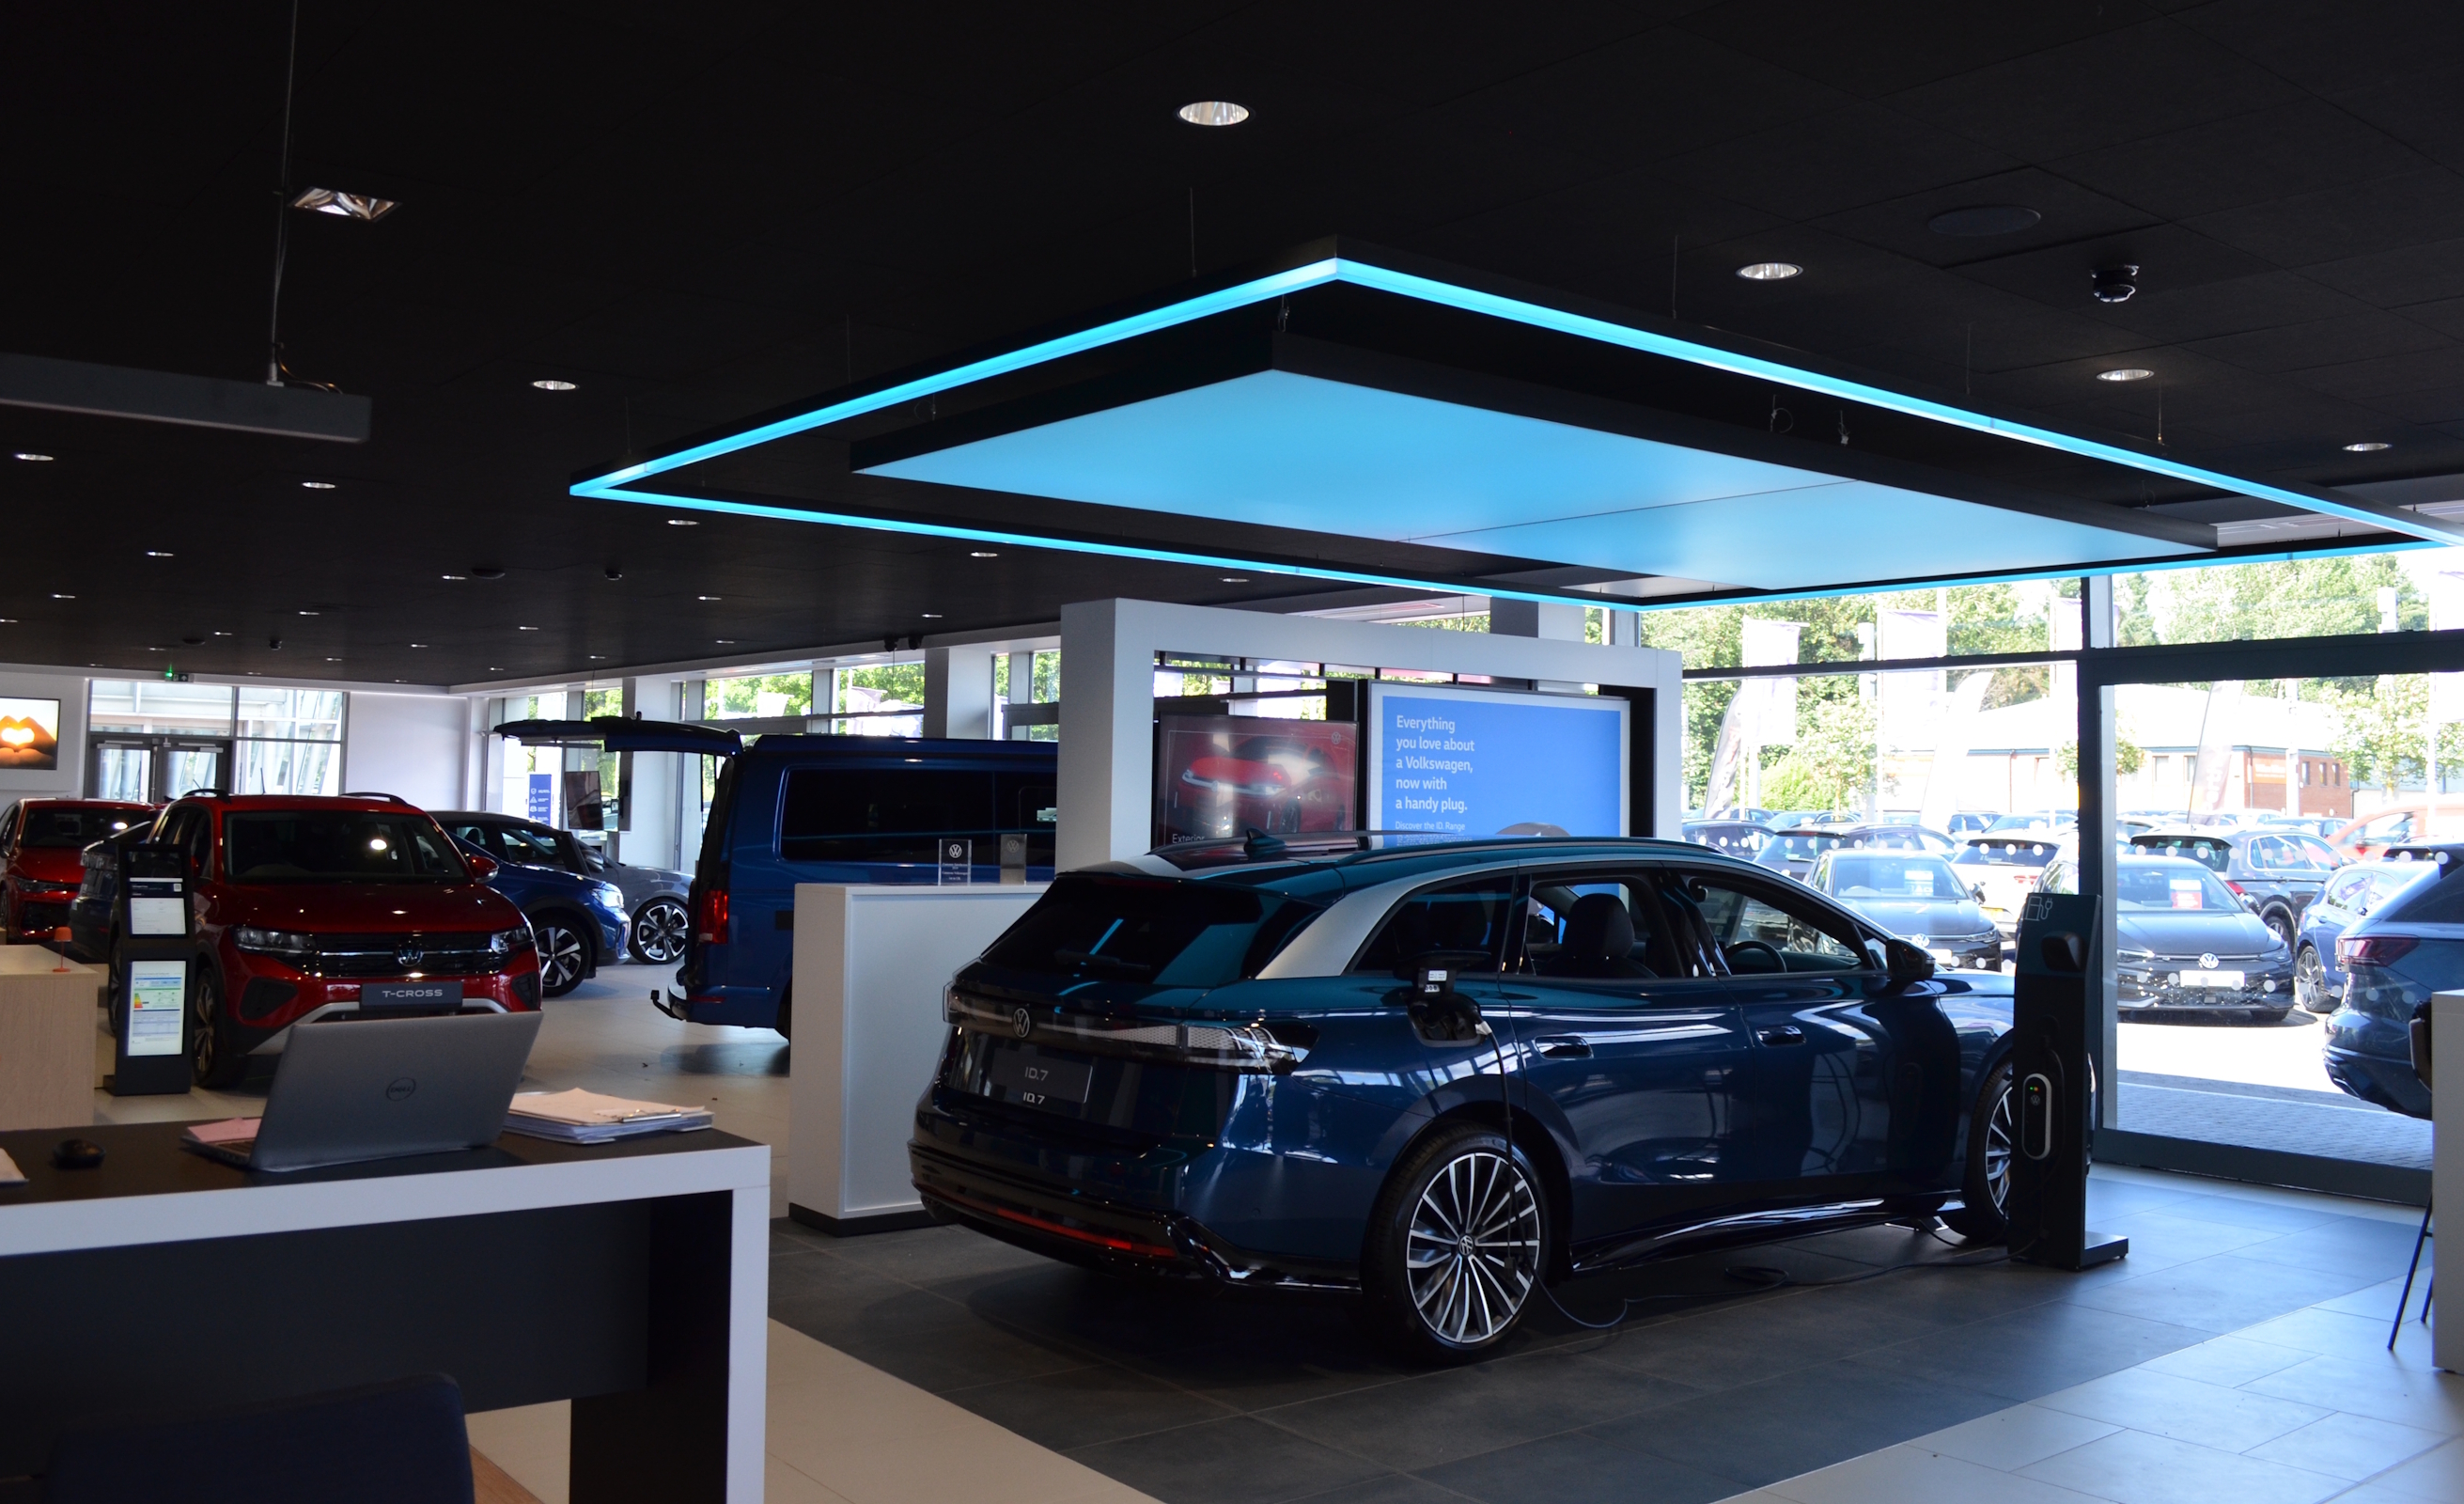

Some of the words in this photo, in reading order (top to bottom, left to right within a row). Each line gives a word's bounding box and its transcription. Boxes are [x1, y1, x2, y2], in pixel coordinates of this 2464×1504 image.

[1396, 715, 1456, 734] Everything
[1396, 738, 1417, 752] you
[1419, 736, 1442, 750] love
[1443, 738, 1475, 752] about
[1396, 759, 1403, 769] a
[1405, 756, 1474, 774] Volkswagen,
[1396, 778, 1420, 789] now
[1422, 776, 1447, 790] with
[1396, 799, 1403, 809] a
[1405, 796, 1439, 813] handy
[1441, 797, 1468, 814] plug.
[1396, 821, 1423, 830] Discover
[1424, 821, 1435, 830] the
[1445, 822, 1466, 832] Range
[382, 989, 444, 998] T-CROSS
[1024, 1066, 1049, 1082] ID.7
